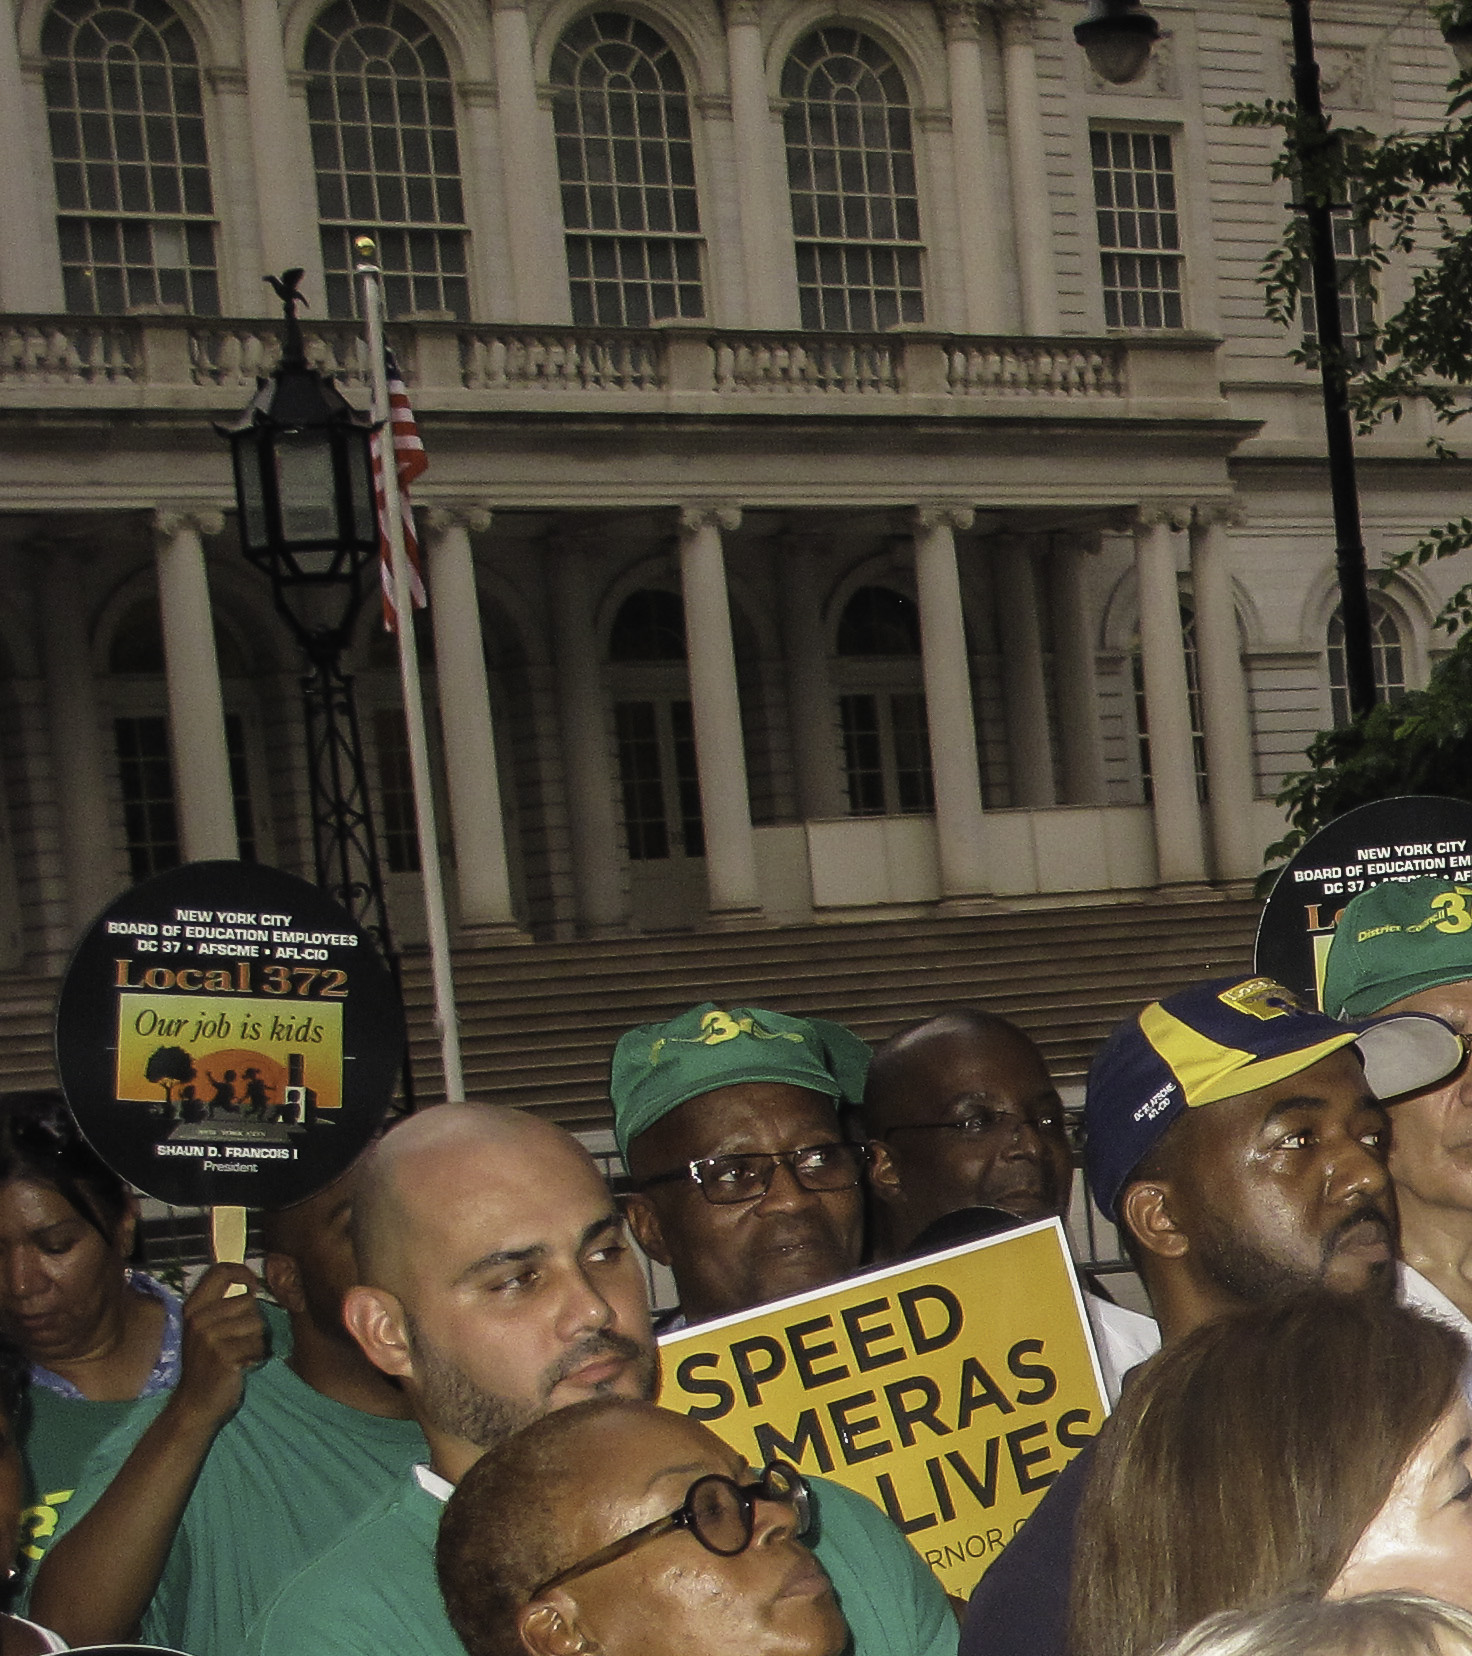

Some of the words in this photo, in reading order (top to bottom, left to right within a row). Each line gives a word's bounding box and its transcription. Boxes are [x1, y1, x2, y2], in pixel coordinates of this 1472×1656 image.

[1357, 846, 1391, 861] NEW
[1394, 843, 1433, 858] YORK
[1436, 840, 1467, 854] CITY
[1294, 867, 1342, 882] BOARD
[1345, 865, 1364, 877] OF
[1367, 857, 1446, 875] EDUCATION
[1323, 883, 1344, 895] DC
[1347, 880, 1365, 893] 37
[176, 909, 213, 923] NEW
[216, 911, 257, 925] YORK
[260, 914, 293, 927] CITY
[107, 921, 158, 936] BOARD
[162, 925, 182, 937] OF
[185, 926, 269, 942] EDUCATION
[272, 931, 359, 947] EMPLOYEES
[137, 939, 159, 952] DC
[162, 941, 181, 953] 37
[199, 943, 260, 957] AFSCME
[275, 947, 329, 961] AFL-CIO
[114, 959, 253, 993] Local
[260, 965, 349, 998] 372
[135, 1009, 189, 1037] Our
[190, 1011, 231, 1043] job
[241, 1013, 263, 1040] is
[270, 1015, 324, 1044] kids
[157, 1145, 204, 1157] SHAUN
[207, 1146, 222, 1158] D.
[225, 1147, 289, 1159] FRANCOIS
[203, 1160, 259, 1173] President
[675, 1283, 964, 1422] SPEED
[753, 1339, 1057, 1474] MERAS
[876, 1408, 1098, 1535] LIVES
[925, 1528, 1006, 1571] RNOR
